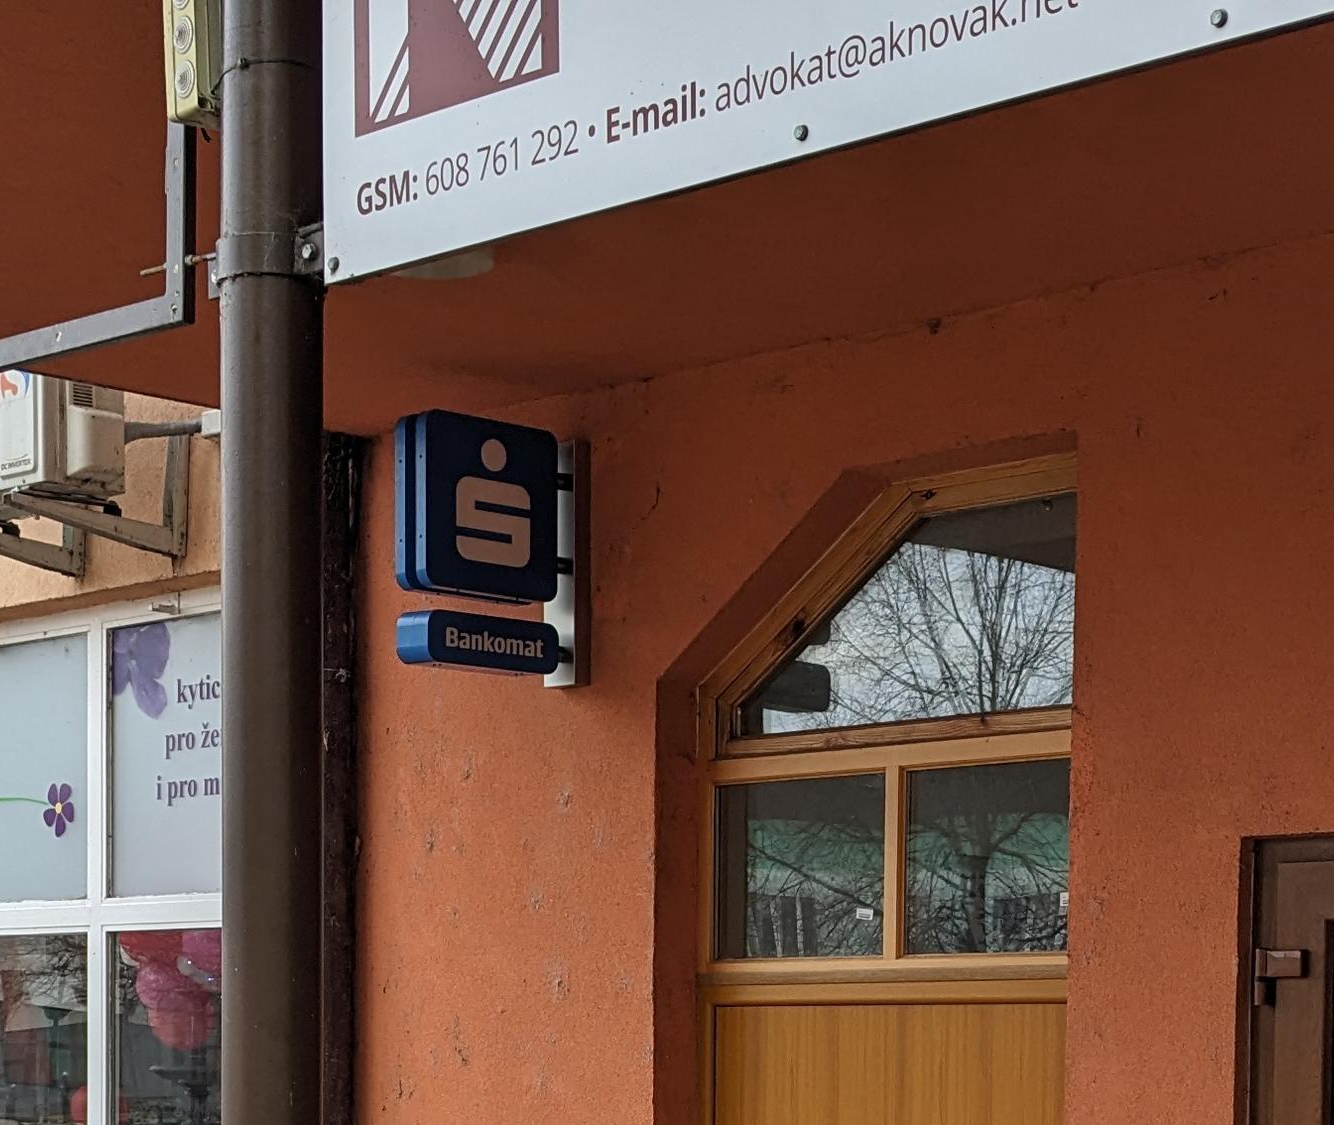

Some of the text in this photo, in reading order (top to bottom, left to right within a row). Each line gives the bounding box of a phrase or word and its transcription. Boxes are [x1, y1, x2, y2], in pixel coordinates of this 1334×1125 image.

[357, 0, 1079, 216] GSM: 608 761 292 E-mail: advokat@aknovak.ne
[445, 626, 544, 659] Bankomat
[165, 722, 222, 760] pro že
[156, 775, 162, 800] i
[167, 779, 198, 807] pro
